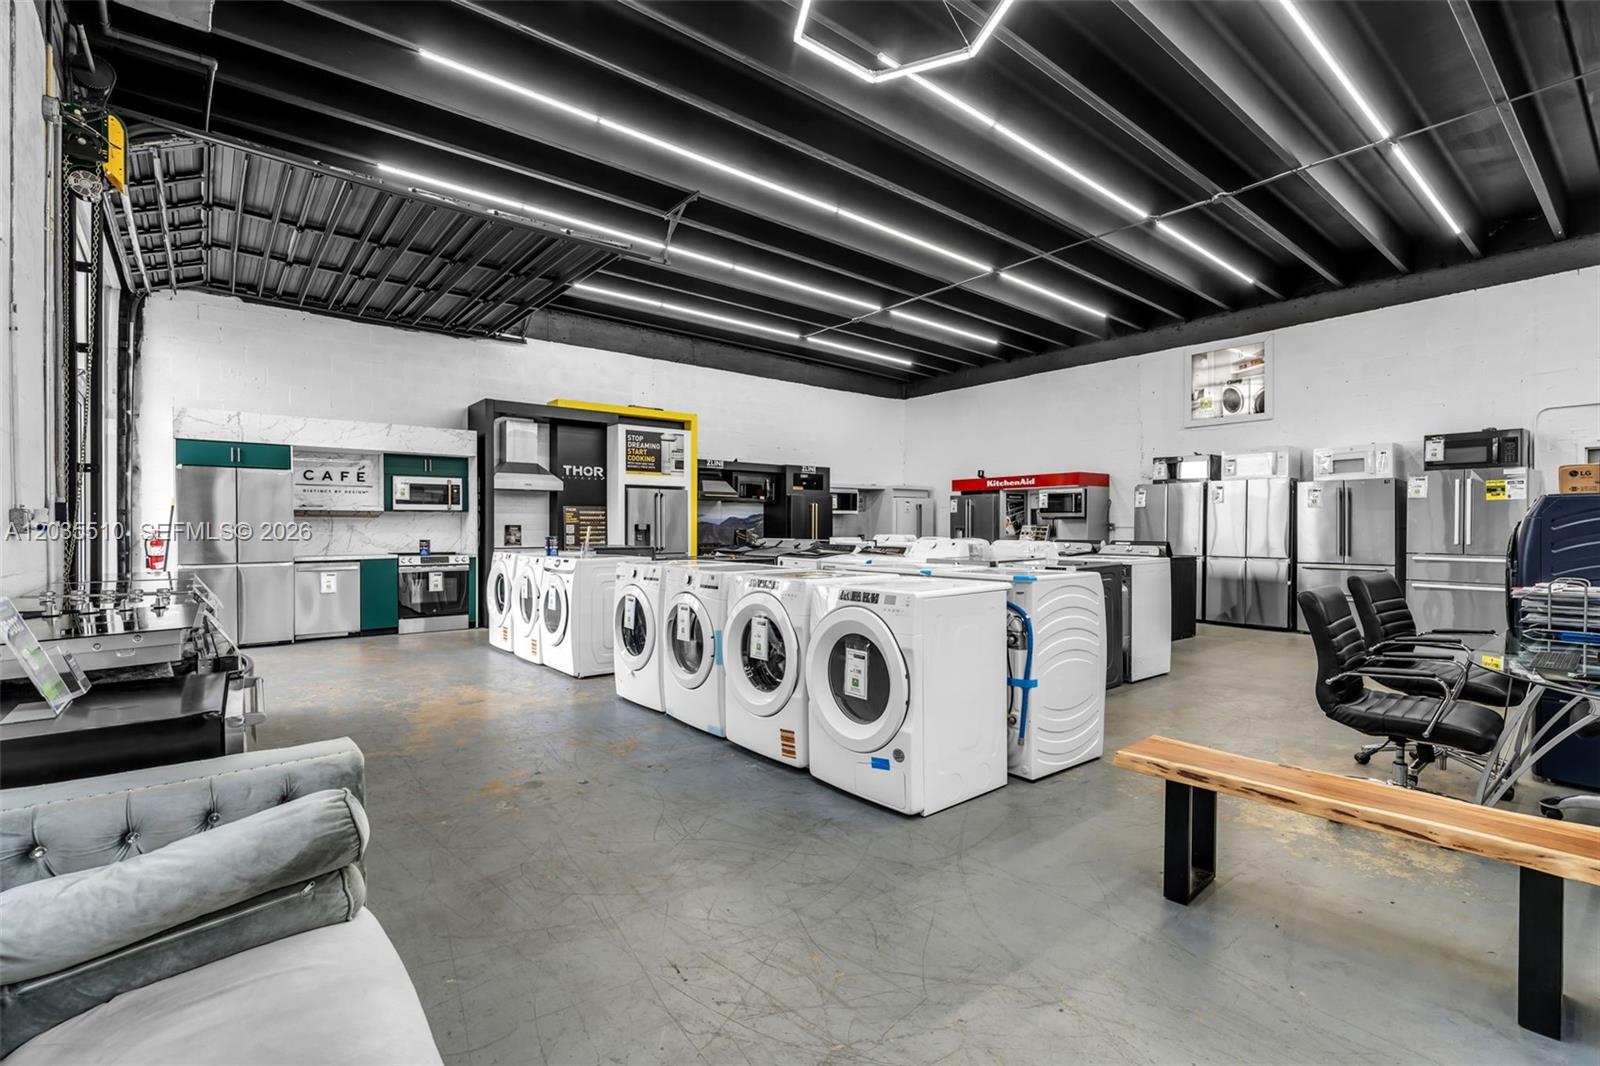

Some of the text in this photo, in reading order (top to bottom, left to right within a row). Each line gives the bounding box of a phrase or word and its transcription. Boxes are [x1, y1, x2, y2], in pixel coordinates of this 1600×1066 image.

[627, 441, 661, 450] DREAMING
[627, 448, 648, 456] START
[303, 465, 366, 482] CAFÉ
[562, 464, 604, 477] THOR
[987, 478, 1035, 487] KitchenAid
